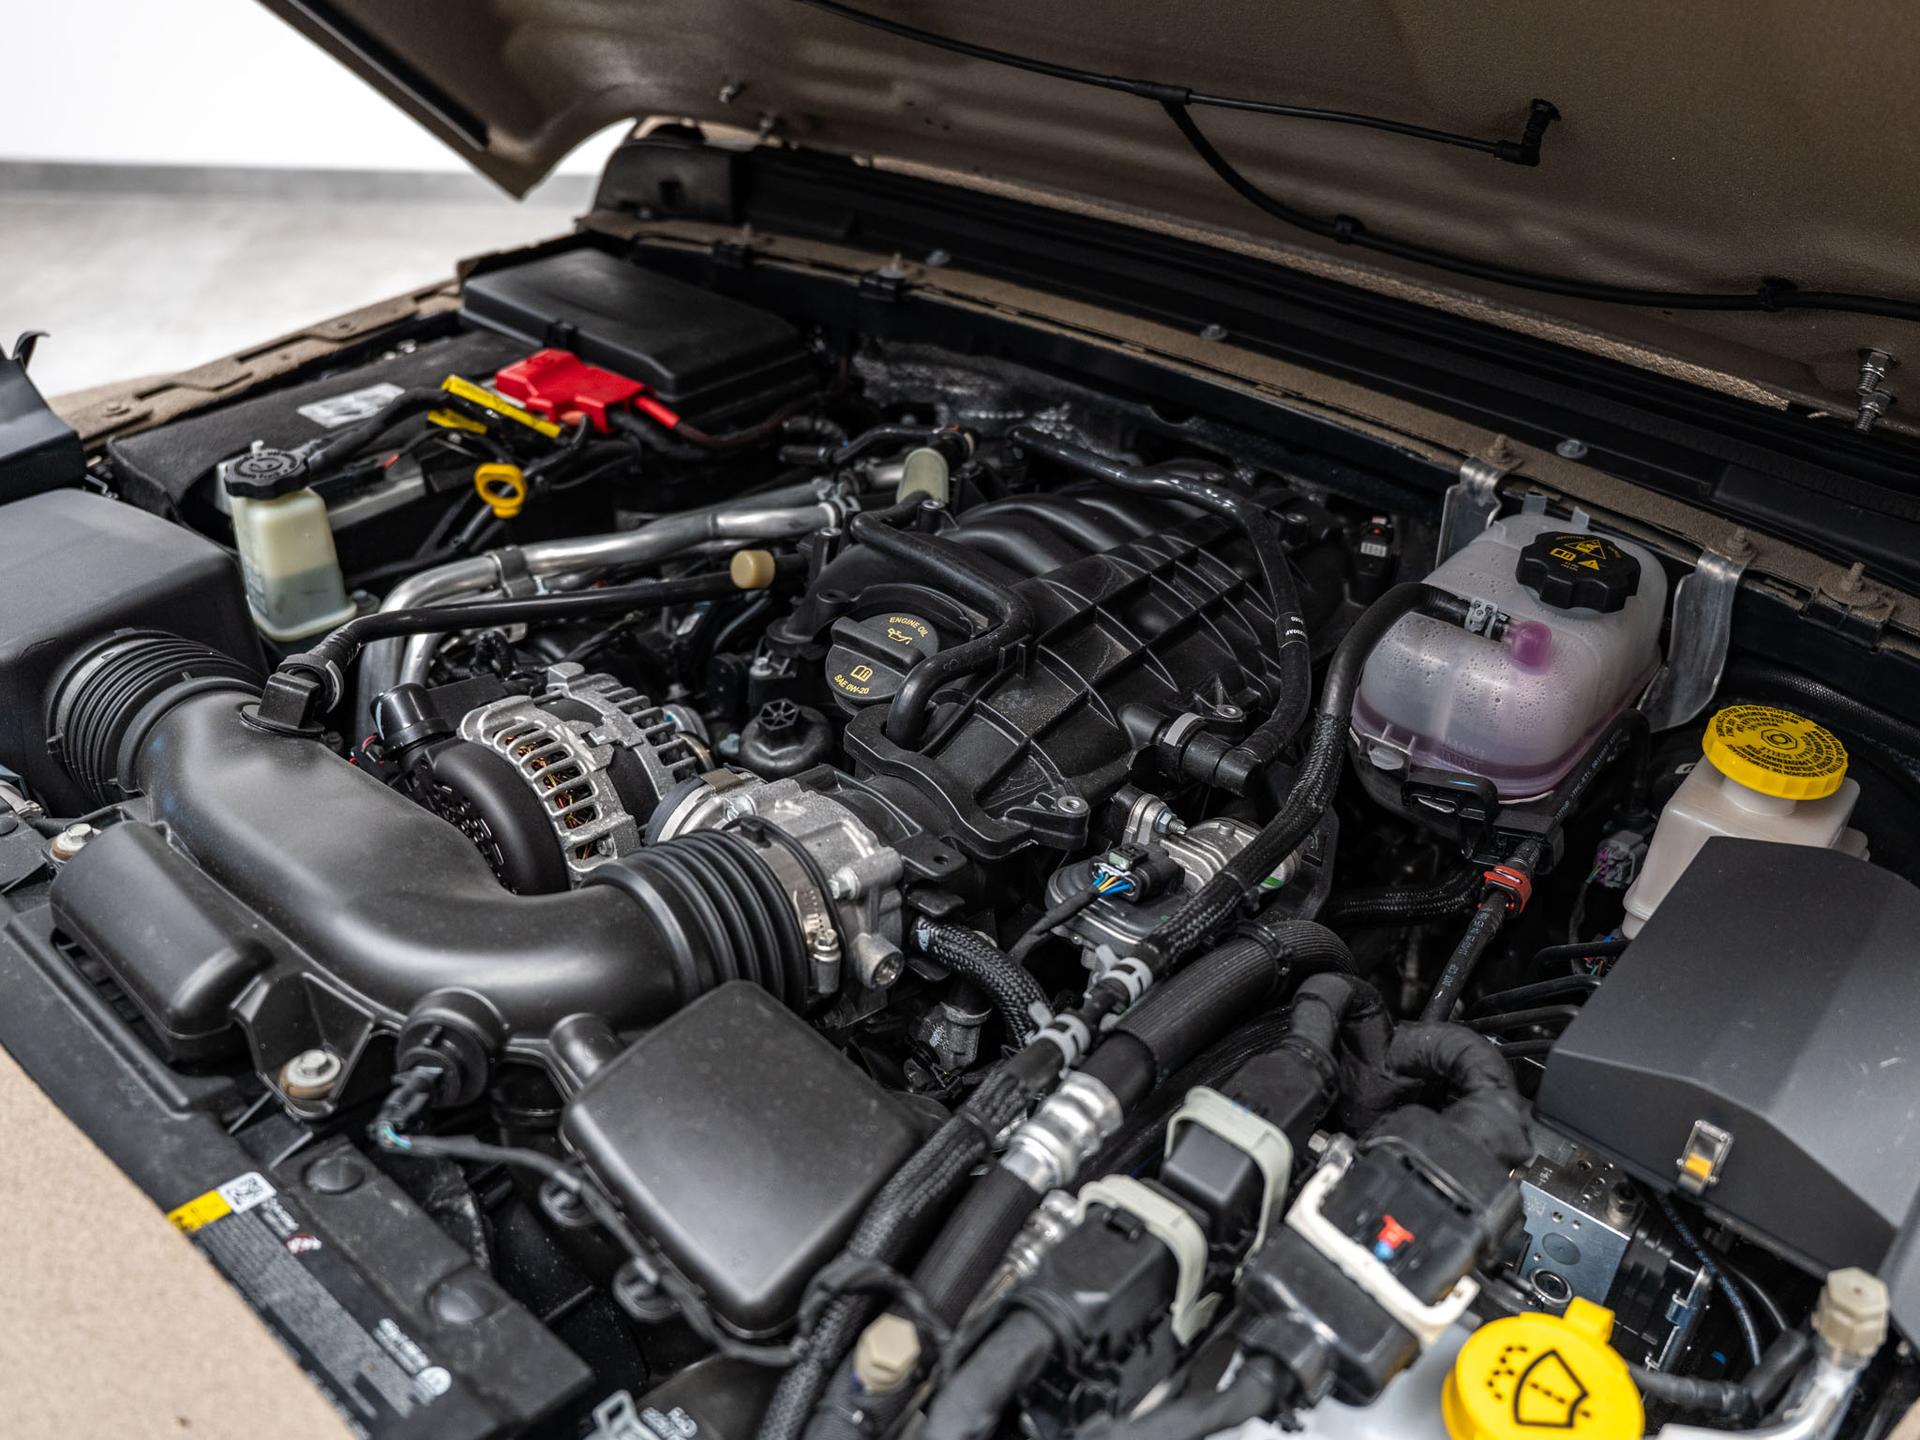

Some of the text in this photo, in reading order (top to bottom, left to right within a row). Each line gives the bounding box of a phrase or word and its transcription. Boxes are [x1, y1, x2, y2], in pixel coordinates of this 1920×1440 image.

[889, 617, 928, 637] ENGINE OIL
[834, 674, 870, 694] SAE 0W-20
